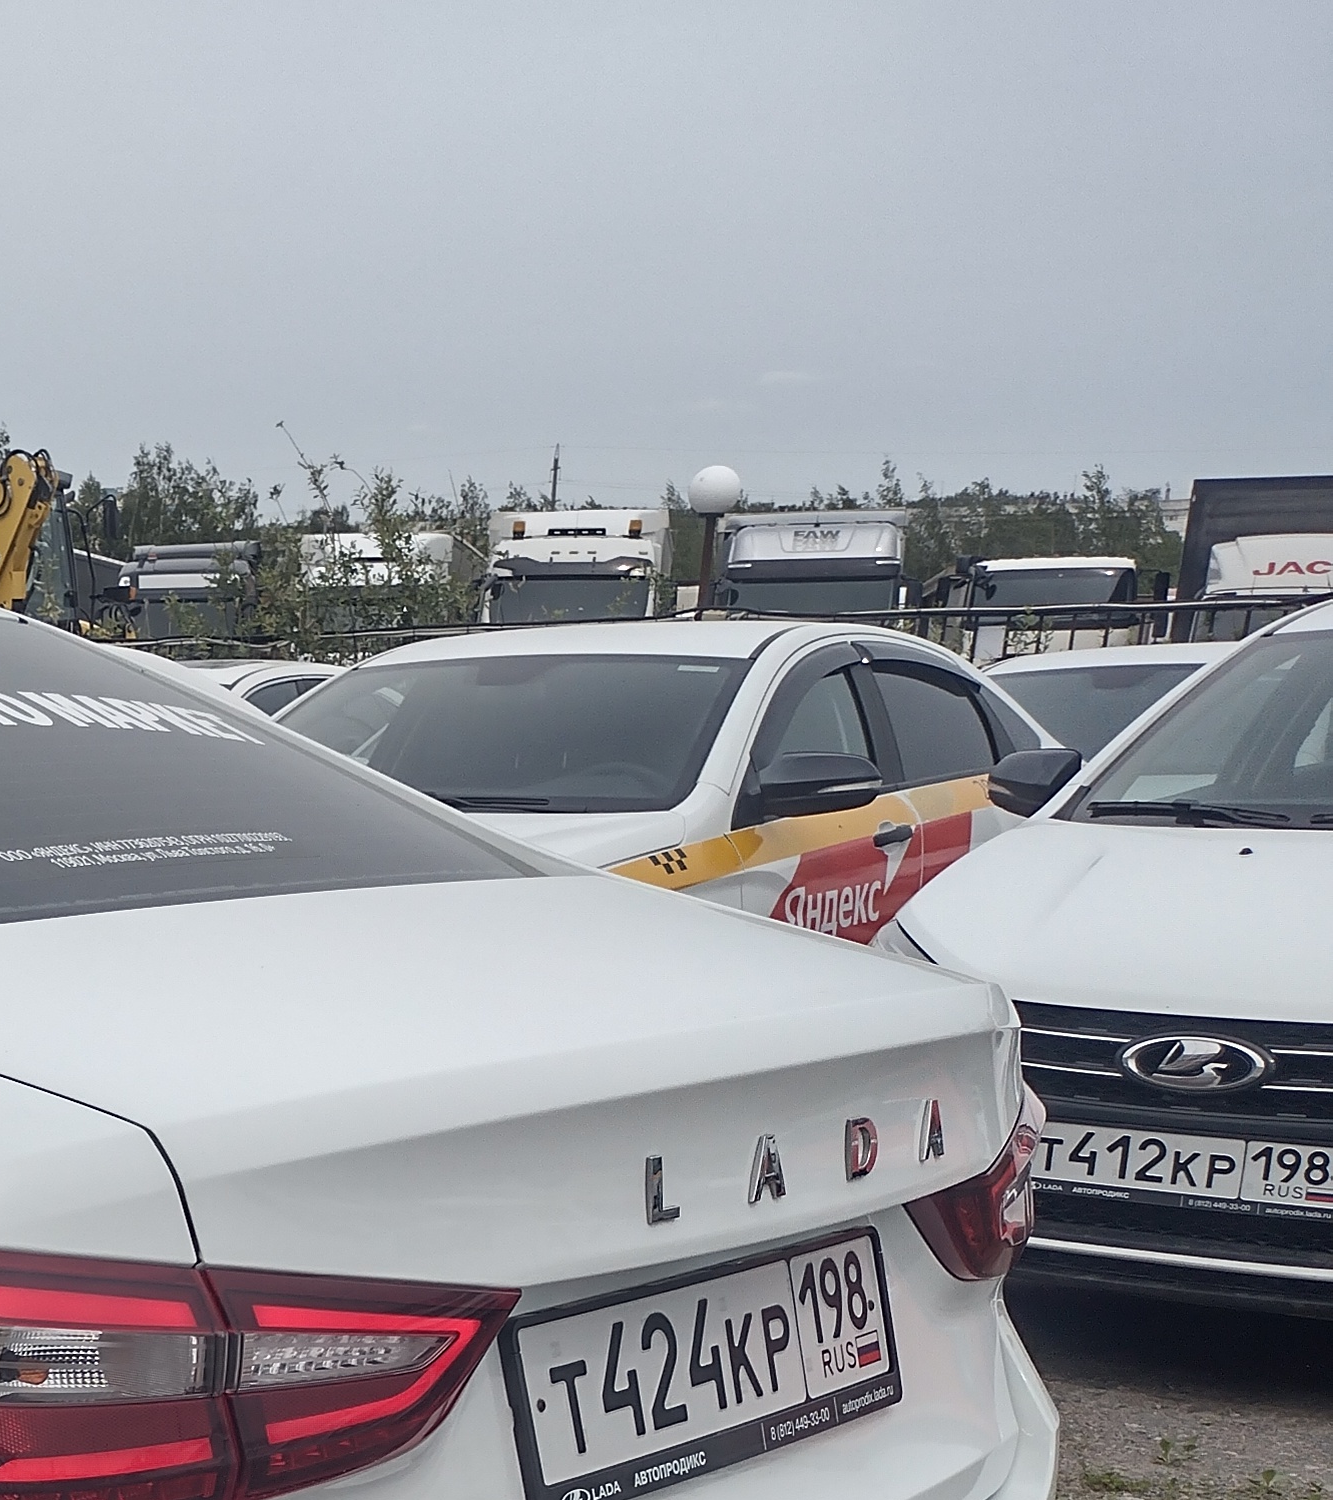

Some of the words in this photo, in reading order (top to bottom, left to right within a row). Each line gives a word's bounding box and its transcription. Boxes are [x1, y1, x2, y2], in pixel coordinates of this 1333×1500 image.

[793, 530, 841, 542] FAW
[1252, 561, 1333, 576] JAC
[17, 690, 265, 745] МАРКЕТ
[90, 839, 124, 852] ИНН
[181, 834, 217, 846] ОГРН
[92, 852, 147, 866] Москва,
[785, 880, 881, 936] Яндекс
[645, 1099, 944, 1226] LADA
[1039, 1132, 1236, 1188] Т412КР
[1251, 1146, 1331, 1186] 198
[1042, 1181, 1063, 1191] LADA
[1072, 1187, 1130, 1199] АВТОПРОДИКС
[1264, 1184, 1303, 1198] RUS
[1194, 1200, 1212, 1208] (812)
[1213, 1201, 1251, 1211] 449-33-00
[1265, 1207, 1331, 1219] autoprodix.lada.ru
[549, 1298, 789, 1454] Т424КР
[798, 1251, 869, 1344] 198
[822, 1341, 857, 1378] RUS
[842, 1385, 894, 1414] autoprodix.lada.ru
[770, 1427, 776, 1441] 8
[777, 1420, 795, 1441] (812)
[795, 1407, 830, 1431] 449-33-00
[634, 1451, 706, 1487] АВТОПРОДИКС
[591, 1480, 621, 1500] LADA
